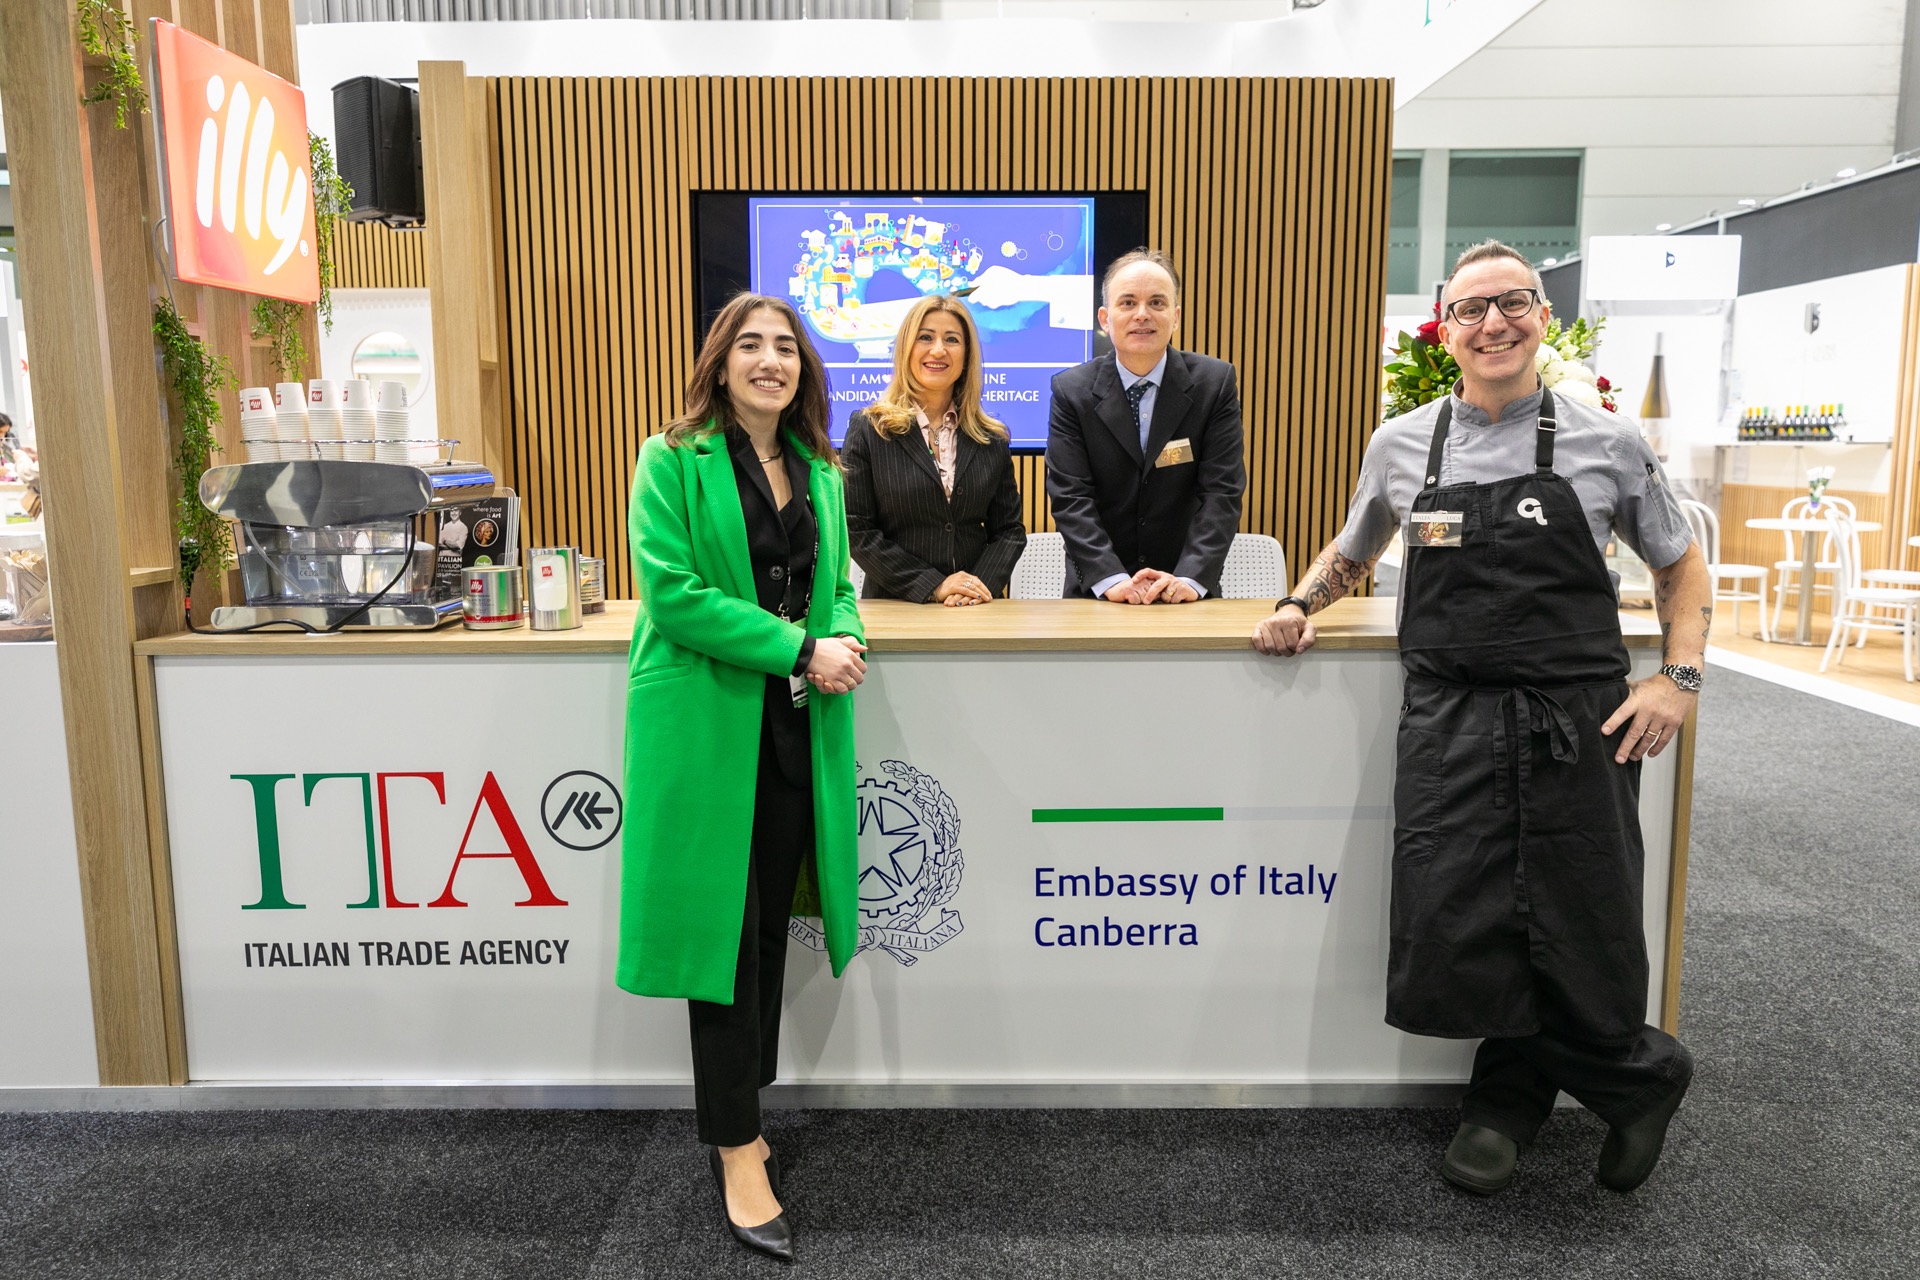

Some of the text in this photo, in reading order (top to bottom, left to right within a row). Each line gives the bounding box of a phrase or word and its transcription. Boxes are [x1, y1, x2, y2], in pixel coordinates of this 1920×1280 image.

[196, 74, 307, 276] illy
[860, 373, 881, 385] AM
[984, 373, 1007, 385] INE
[828, 390, 885, 402] ANDIDAT
[1034, 864, 1338, 905] Embassy of Italy
[890, 923, 958, 950] ITALIANA
[1034, 916, 1199, 947] Canberra
[244, 939, 570, 968] ITALIAN TRADE AGENCY
